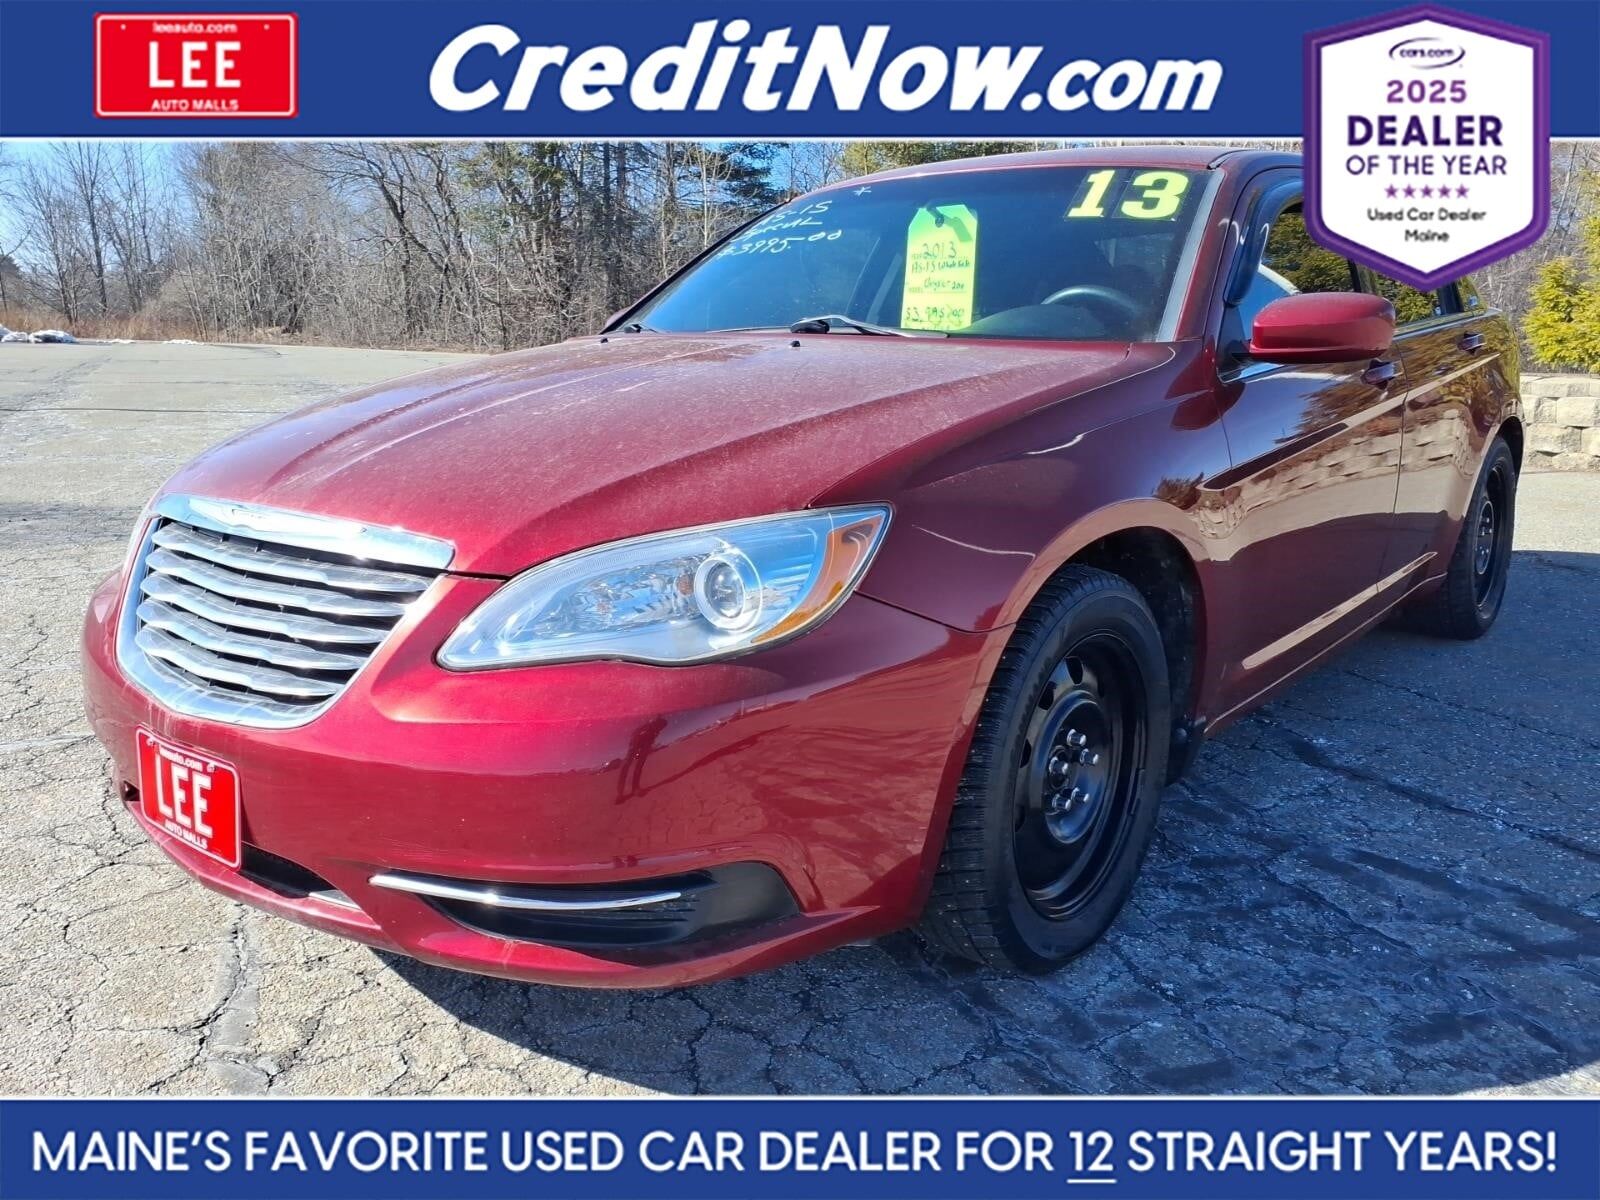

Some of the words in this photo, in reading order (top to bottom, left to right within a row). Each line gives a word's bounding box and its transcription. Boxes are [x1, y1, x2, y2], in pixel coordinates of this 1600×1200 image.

[1067, 169, 1189, 218] 13
[155, 752, 213, 839] LEE
[164, 818, 183, 837] AUTO
[182, 828, 209, 850] MALLS
